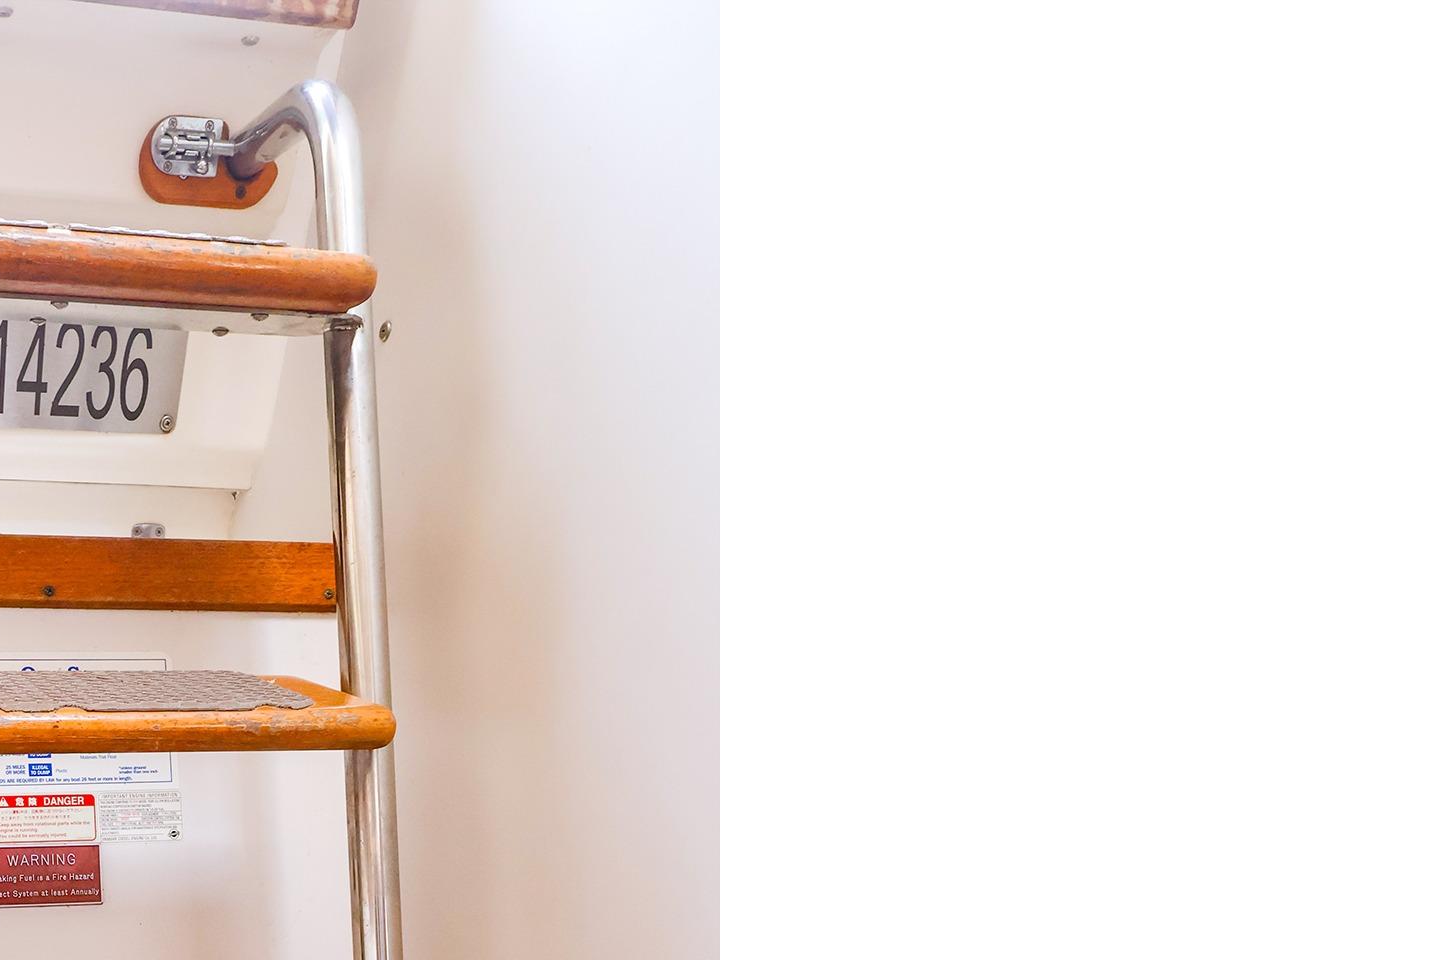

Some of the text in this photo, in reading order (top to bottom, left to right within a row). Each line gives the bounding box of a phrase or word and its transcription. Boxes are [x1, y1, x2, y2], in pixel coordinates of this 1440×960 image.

[43, 796, 84, 806] DANGER
[7, 853, 76, 867] WARNING
[69, 872, 95, 880] Hazard
[12, 890, 39, 898] System
[70, 888, 100, 896] Annually
